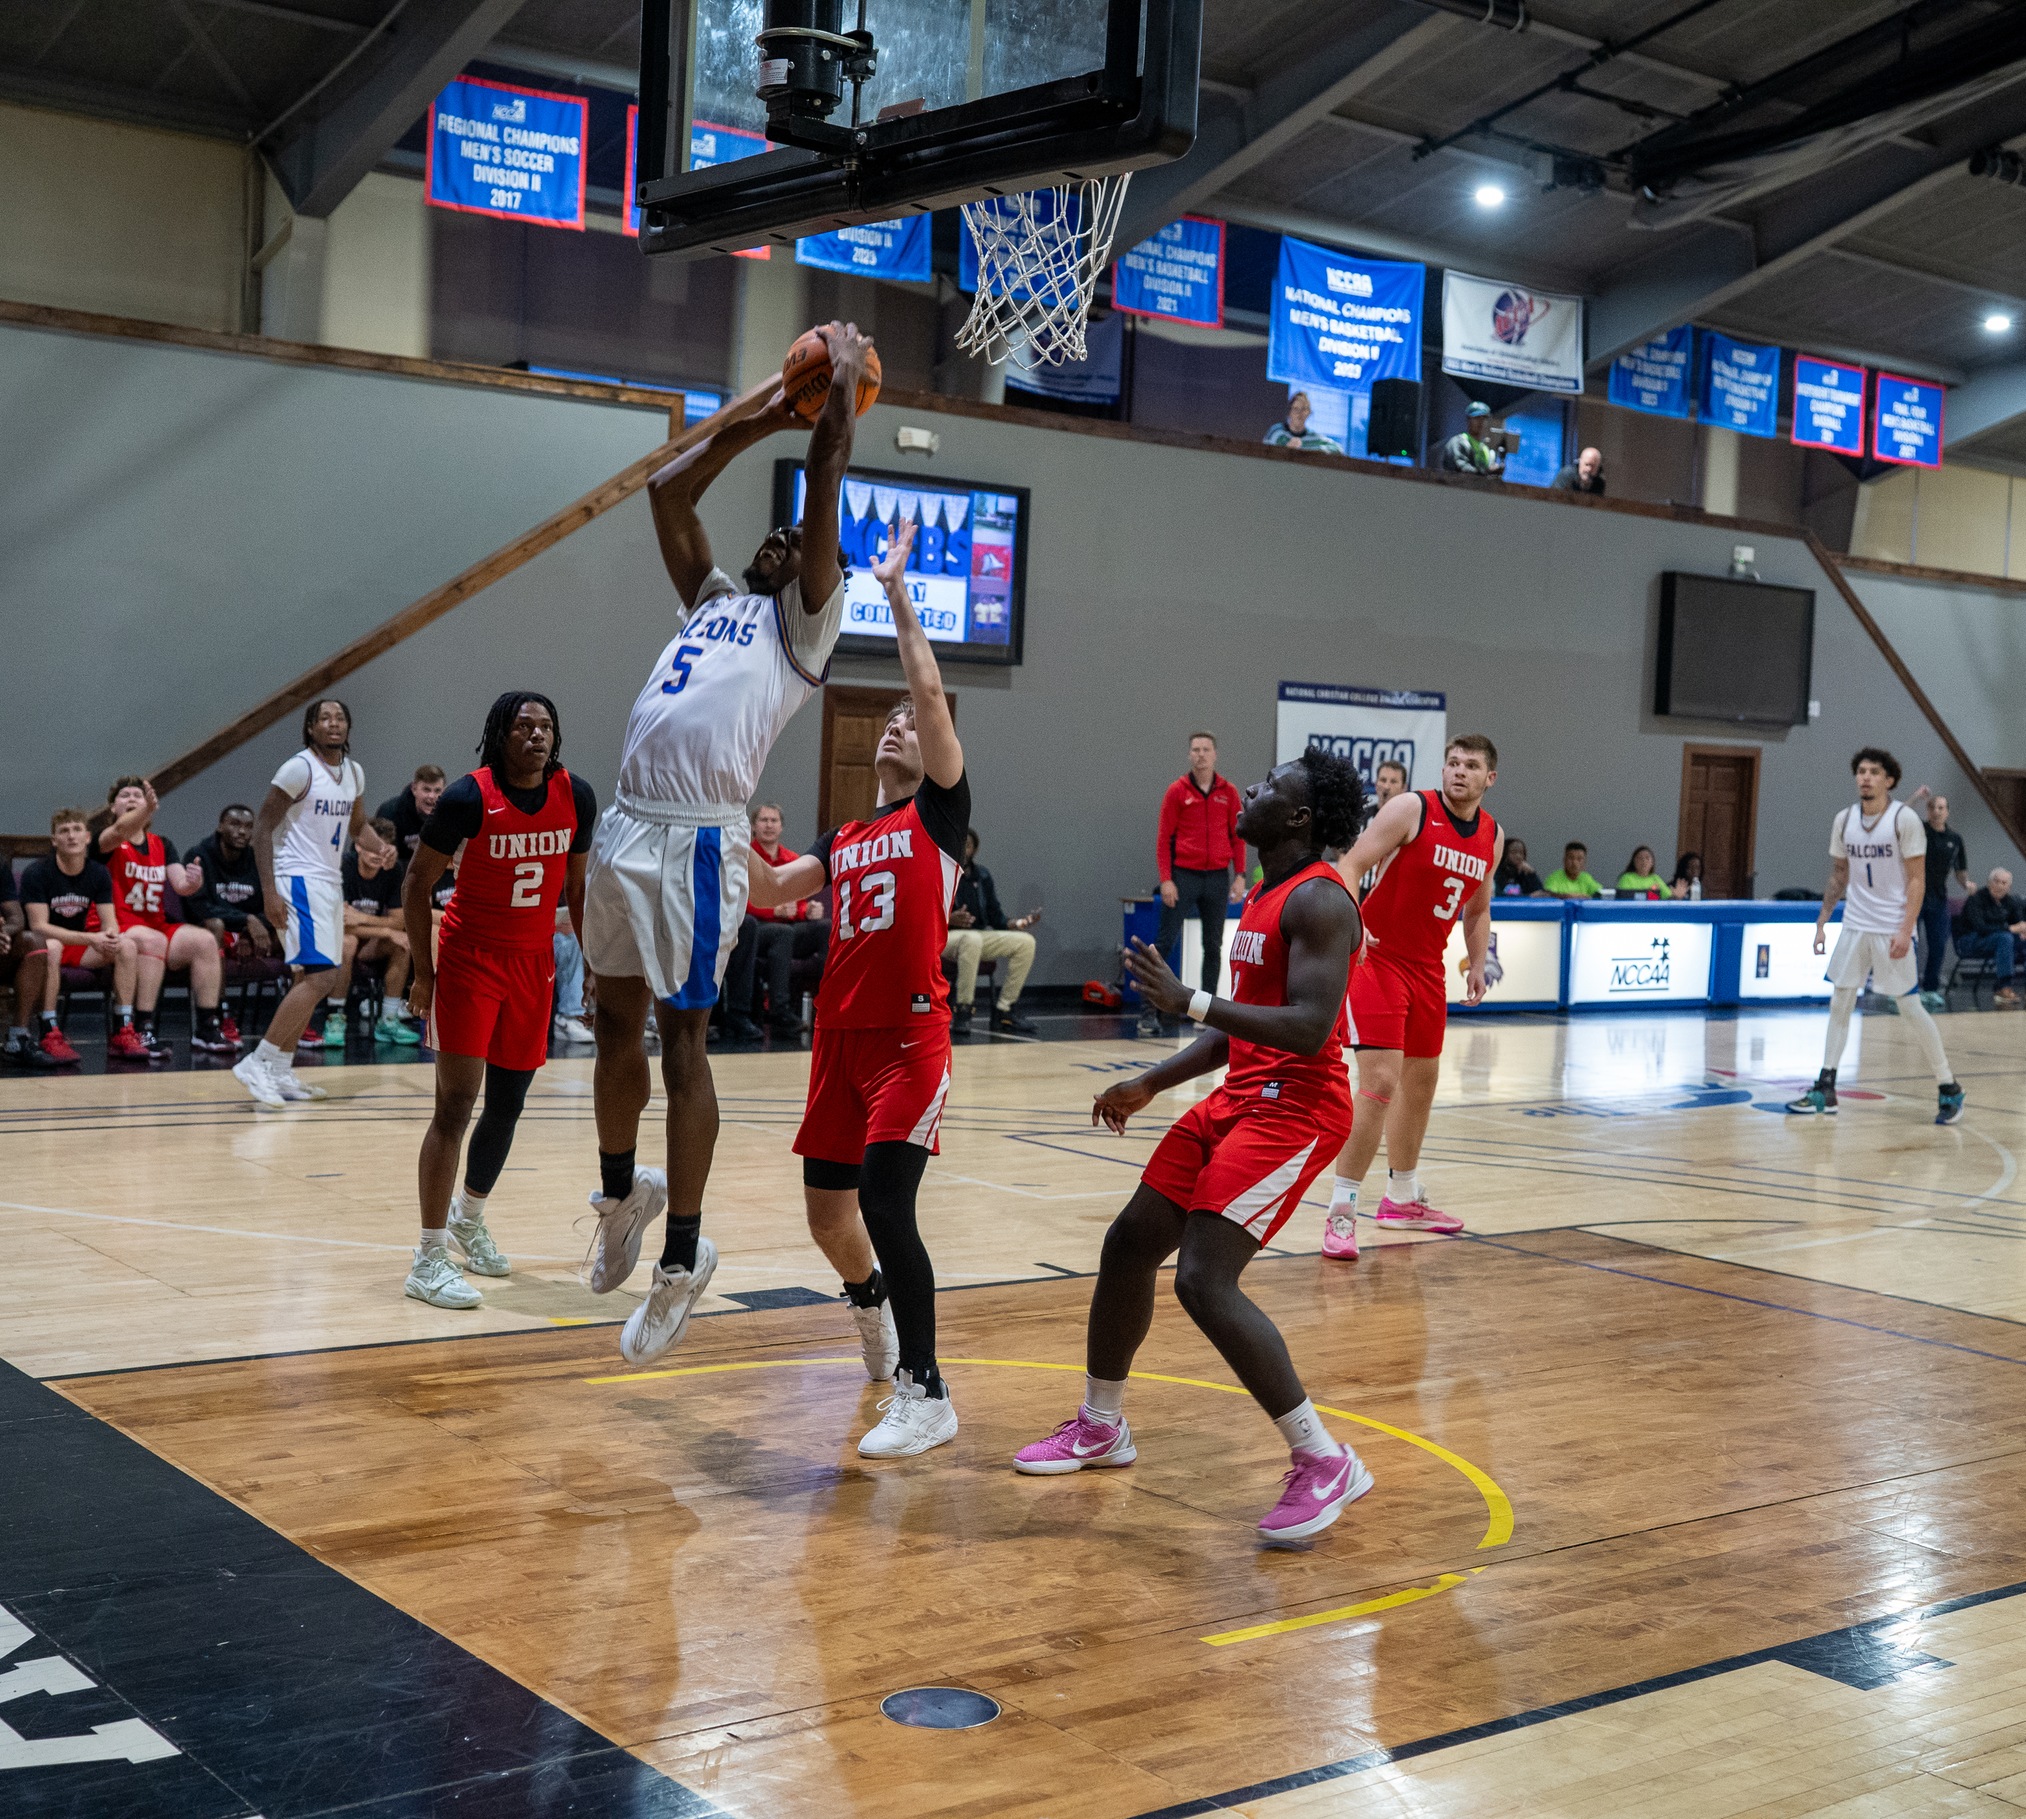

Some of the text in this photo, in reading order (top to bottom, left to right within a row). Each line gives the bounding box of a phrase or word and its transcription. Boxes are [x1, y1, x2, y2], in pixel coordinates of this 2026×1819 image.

[437, 113, 580, 156] REGIONAL CHAMPIONS
[460, 140, 555, 173] MEN'S SOCCER
[473, 163, 542, 192] DIVISION II
[490, 188, 523, 210] 2017
[1285, 285, 1412, 325] NATIONAL CHAMPIONS
[1289, 308, 1329, 332] MEN'S
[1318, 336, 1370, 361] DIVISION
[850, 601, 957, 632] CONCTED
[661, 644, 704, 695] 5
[314, 799, 353, 816] FALCON
[330, 821, 342, 852] 4
[488, 828, 572, 859] UNION
[1846, 843, 1893, 858] FALCONS
[829, 829, 914, 880] UNION
[1432, 844, 1488, 883] UNION
[125, 861, 167, 883] UNION
[510, 861, 544, 908] 2
[1866, 863, 1874, 888] 1
[124, 881, 164, 913] 45
[839, 870, 896, 941] 13
[1433, 876, 1465, 921] 3
[1230, 930, 1267, 966] NION
[1610, 964, 1670, 986] NCCAA
